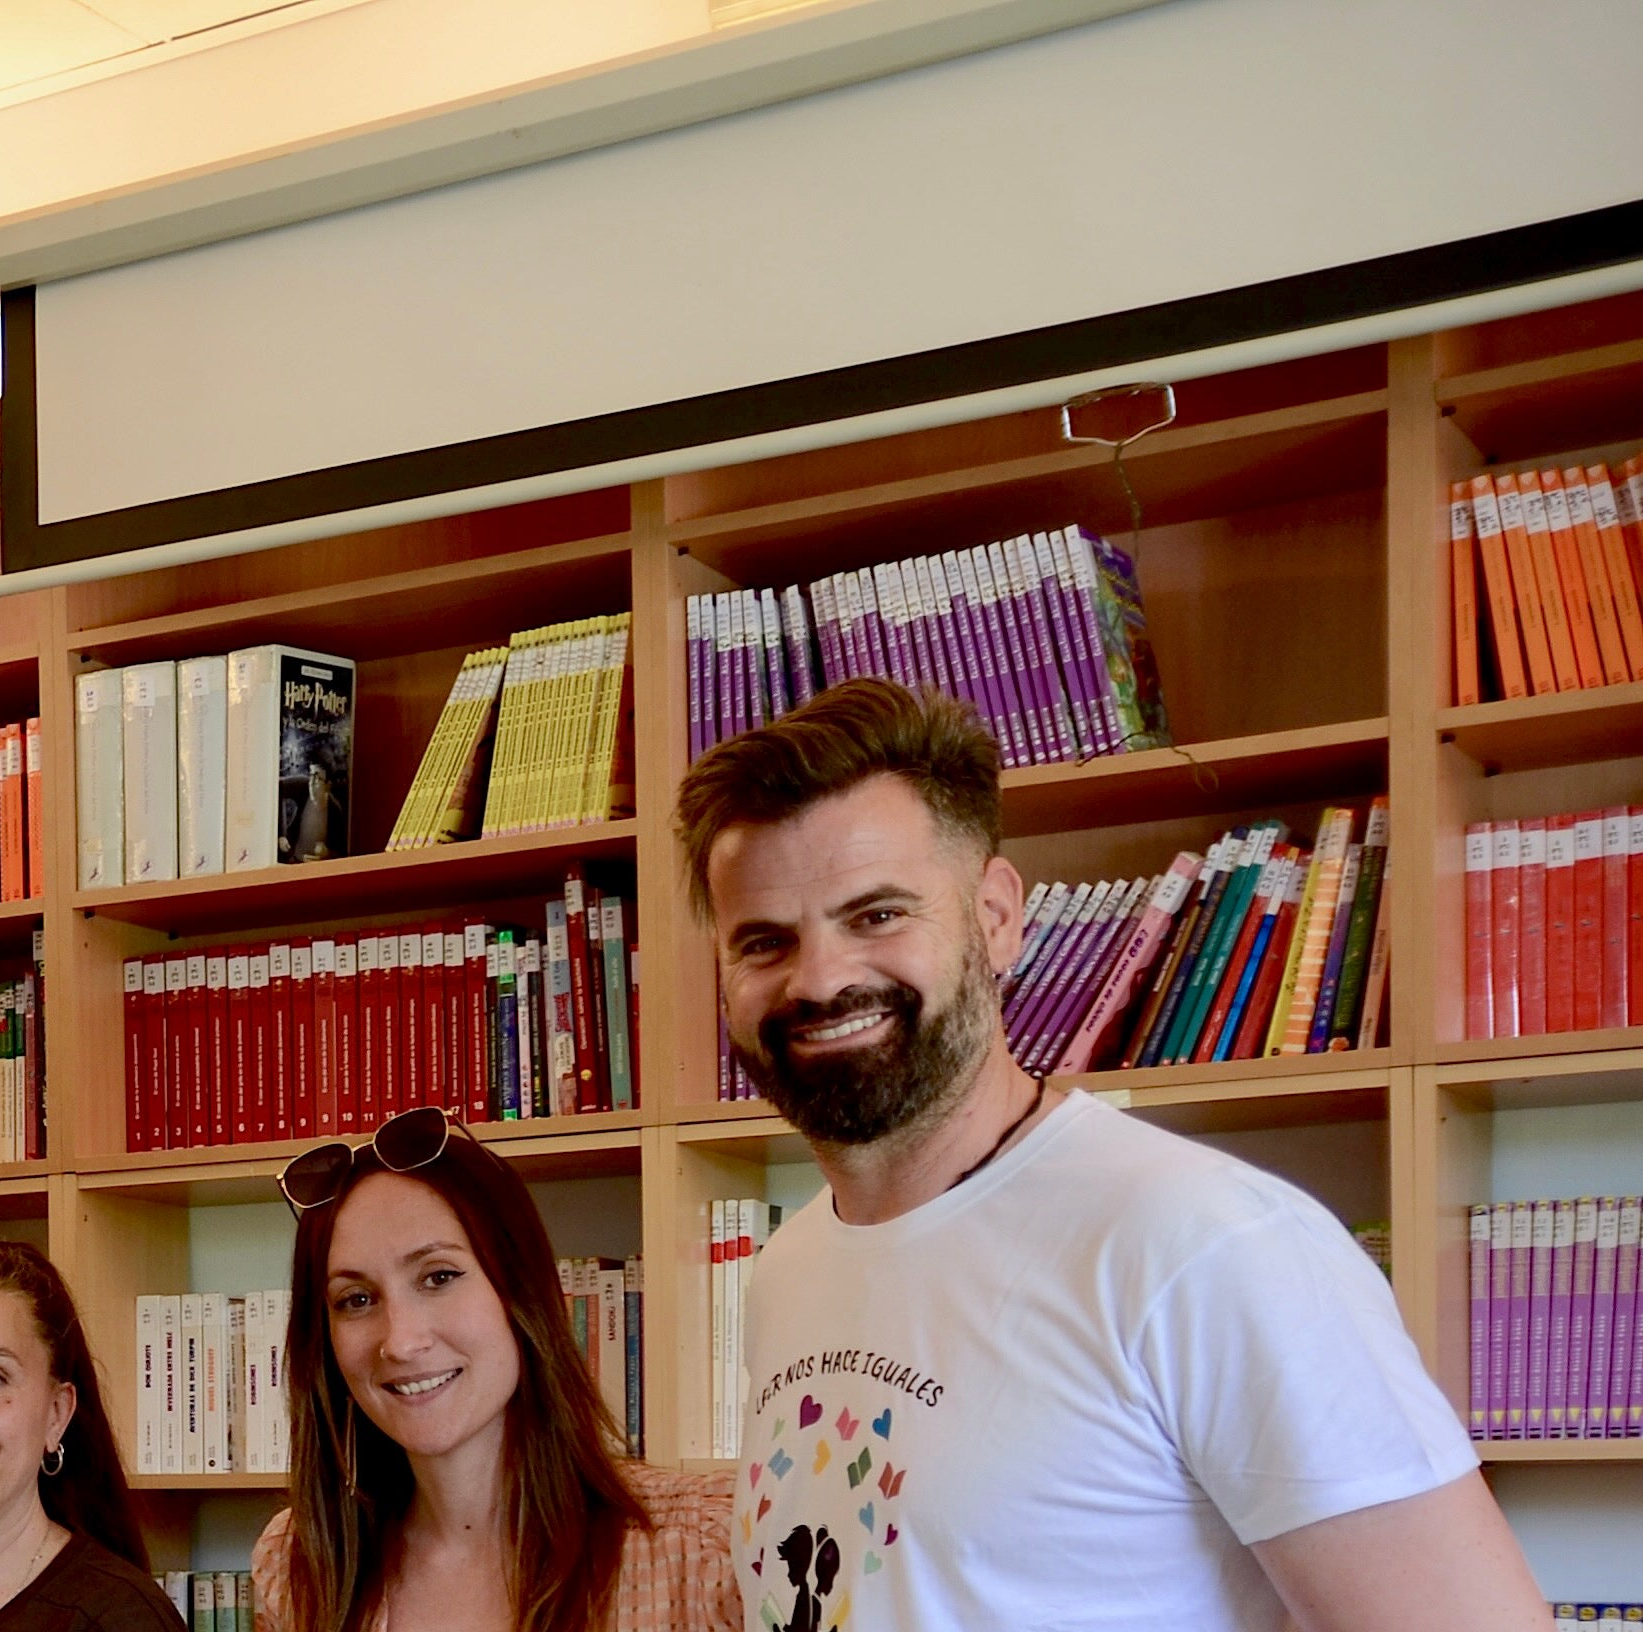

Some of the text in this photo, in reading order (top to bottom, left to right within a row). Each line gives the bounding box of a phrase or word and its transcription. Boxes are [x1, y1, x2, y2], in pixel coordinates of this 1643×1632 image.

[284, 681, 349, 717] Harry Potter
[785, 1356, 815, 1384] NOS
[821, 1349, 861, 1375] HACE
[861, 1352, 944, 1407] IGUALES
